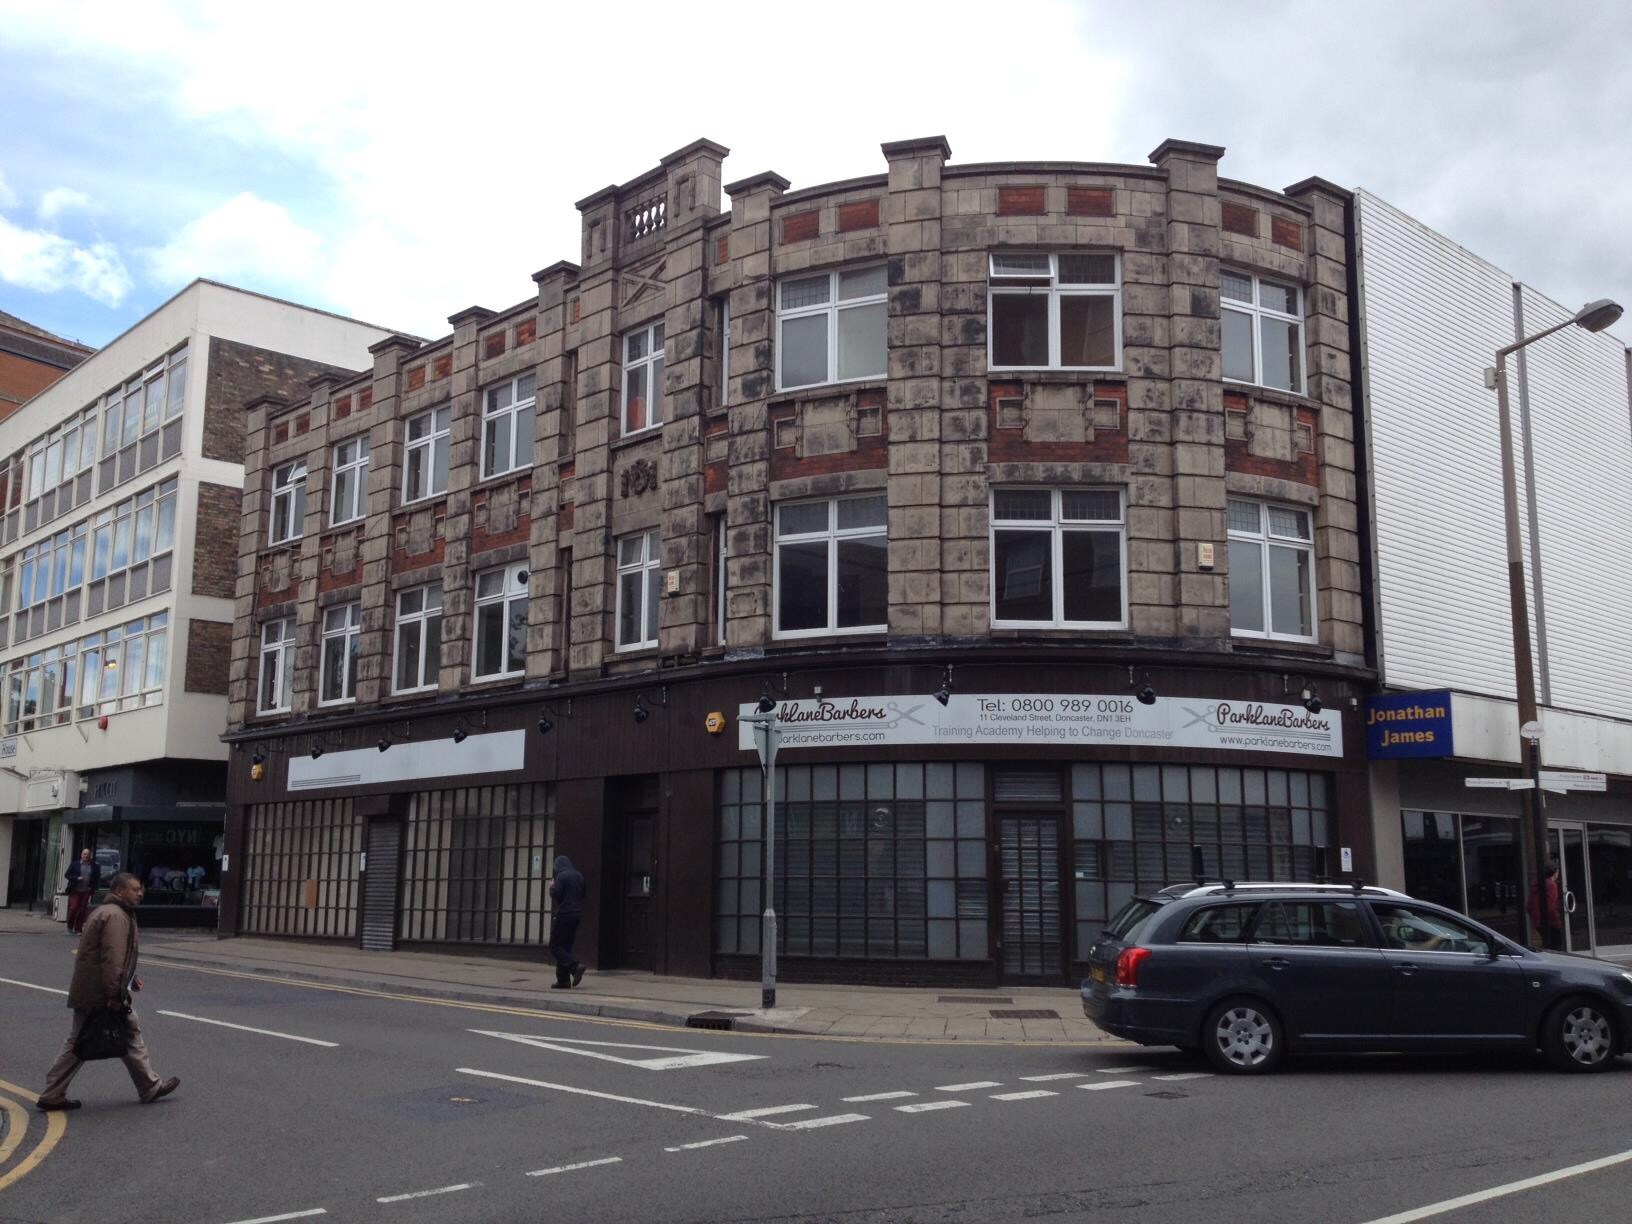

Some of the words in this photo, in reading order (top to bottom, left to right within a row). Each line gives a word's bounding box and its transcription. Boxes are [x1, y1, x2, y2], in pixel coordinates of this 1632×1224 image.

[977, 698, 1006, 712] Tel:
[1012, 698, 1054, 712] 0800
[1060, 699, 1091, 712] 989
[1097, 700, 1134, 713] 0016
[980, 713, 988, 721] 11
[990, 713, 1027, 721] Cleveland
[1029, 713, 1054, 722] Street,
[1096, 714, 1114, 722] DN1
[1116, 714, 1132, 723] 3EH
[1367, 705, 1446, 725] Jonathan
[932, 725, 973, 738] Training
[975, 725, 1024, 738] Academy
[1026, 725, 1067, 739] Helping
[1069, 726, 1080, 737] to
[1081, 726, 1122, 740] Change
[1124, 727, 1175, 740] Doncaster
[1381, 729, 1435, 747] James
[1219, 735, 1331, 752] www.parklanebarbers.com
